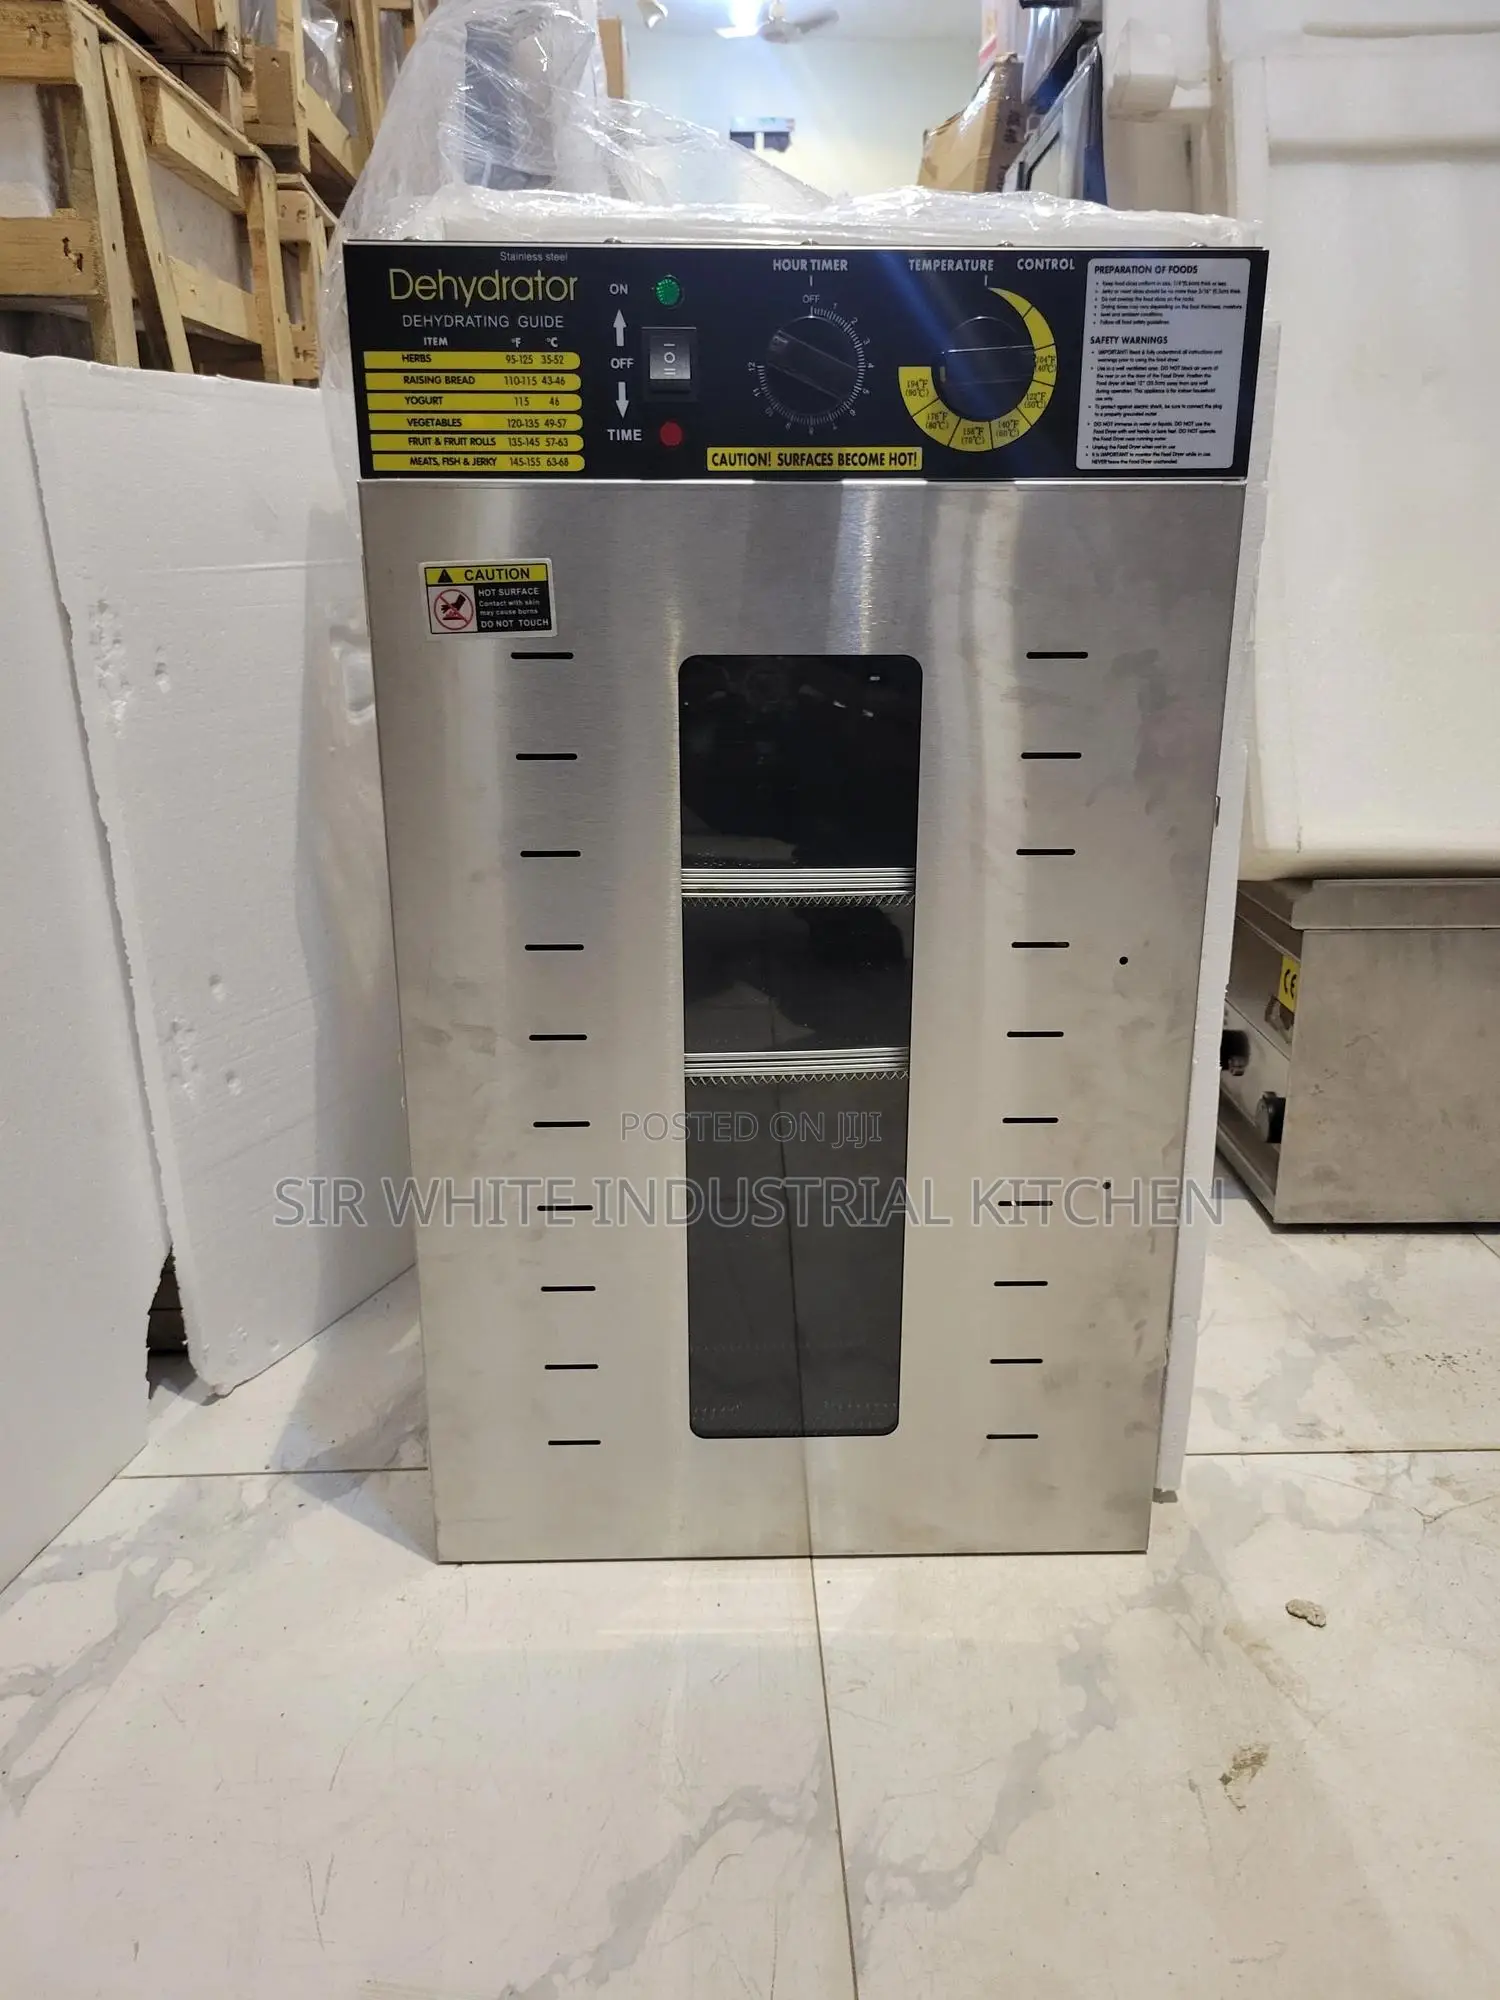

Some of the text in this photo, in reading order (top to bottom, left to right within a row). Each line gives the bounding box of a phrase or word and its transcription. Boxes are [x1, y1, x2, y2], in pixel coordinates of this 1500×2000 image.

[500, 251, 568, 262] Stainless steel
[773, 259, 848, 271] HOUR TIMER
[908, 258, 1075, 272] TEMPERATURE CONTROL
[1094, 265, 1198, 274] PREPARATION OF FOODS
[388, 268, 579, 308] Dehydrator
[609, 283, 628, 295] ON
[802, 294, 820, 304] OFF
[402, 315, 564, 328] DEHYDRATING GUIDE
[424, 337, 448, 346] ITEM
[1090, 336, 1168, 345] SAFETY WARNINGS
[402, 354, 564, 364] HERBS 95-125 35-52
[611, 358, 634, 369] OFF
[403, 376, 566, 386] RAISING BREAD 110-115 43-46
[405, 396, 560, 406] YOGURT 115 46
[406, 418, 567, 428] VEGETABLES 120-135 49-57
[607, 429, 642, 441] TIME
[408, 437, 568, 447] FRUIT & FRUIT ROLLS 135-145 57-63
[409, 457, 569, 467] MEATS, FISH & JERKY 145-155 63-68
[711, 452, 917, 467] CAUTION! SURFACES BECOME HOT!
[464, 567, 530, 581] CAUTION
[478, 587, 540, 597] HOT SURFACE
[479, 600, 507, 608] Contact
[480, 609, 494, 617] may
[517, 607, 538, 615] burns
[481, 618, 549, 629] DO NOT TOUCH
